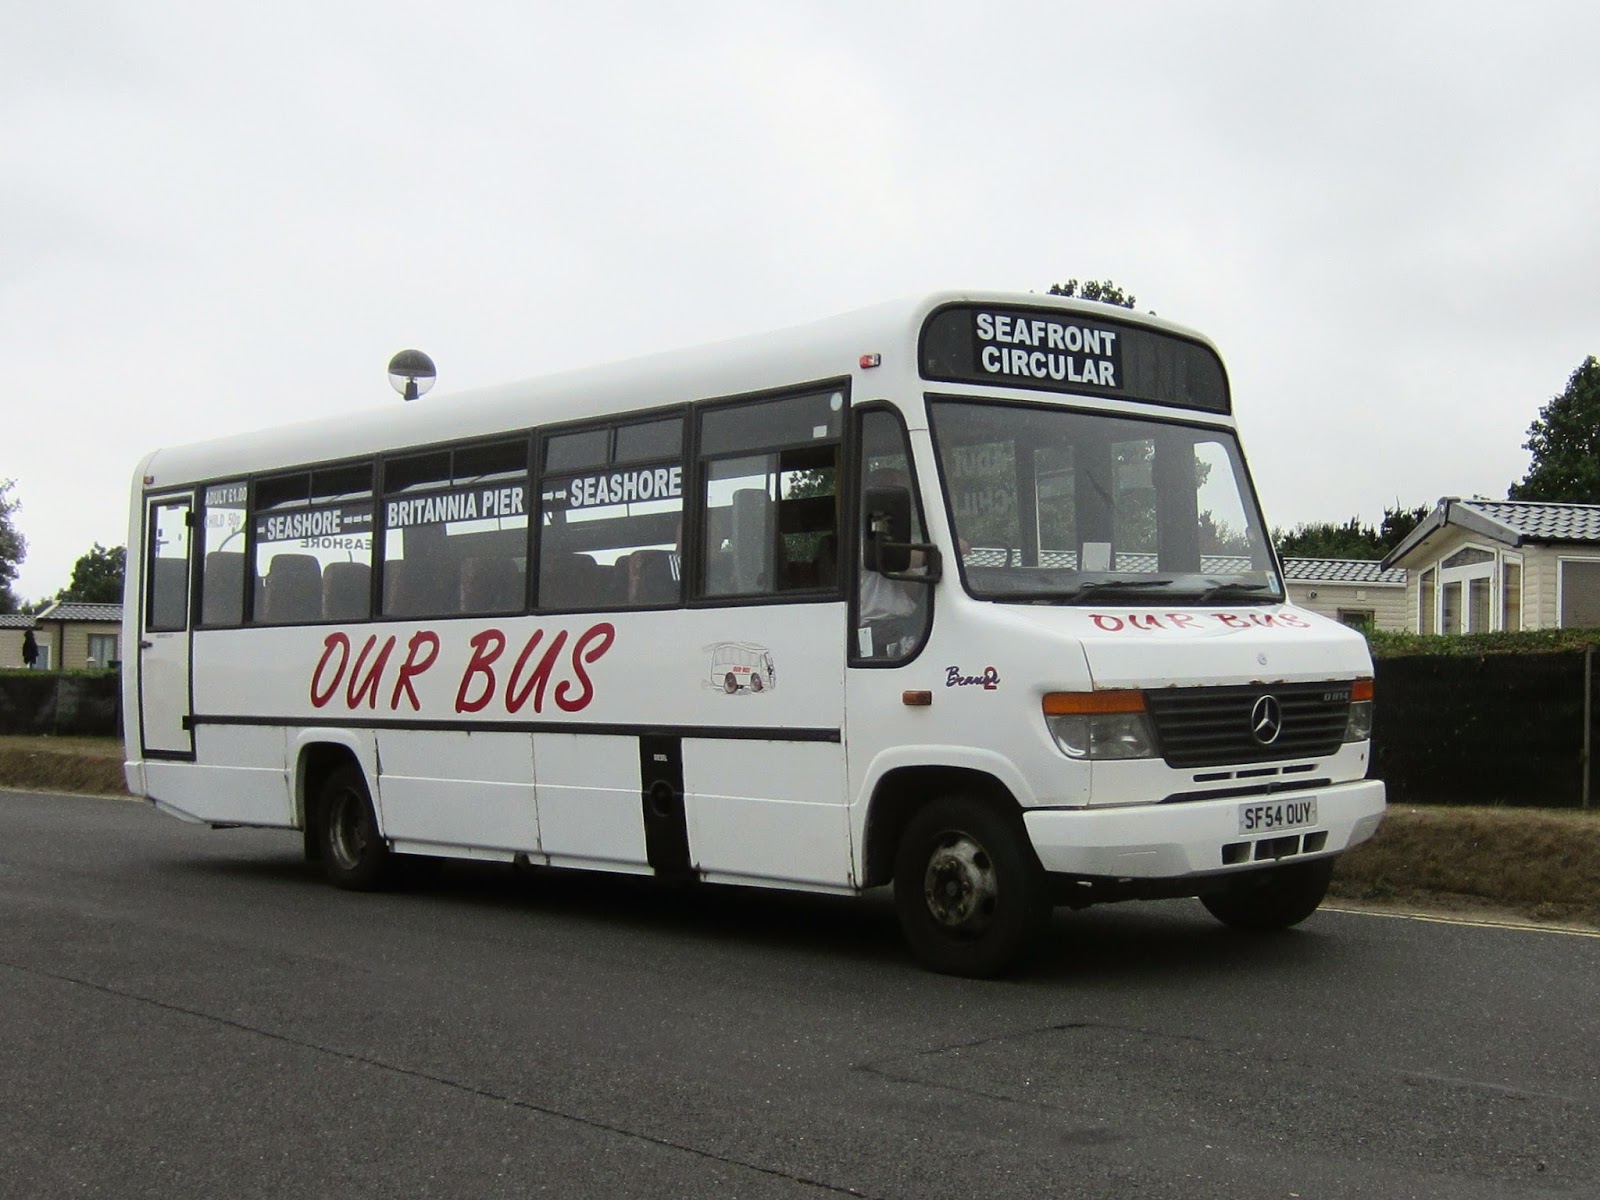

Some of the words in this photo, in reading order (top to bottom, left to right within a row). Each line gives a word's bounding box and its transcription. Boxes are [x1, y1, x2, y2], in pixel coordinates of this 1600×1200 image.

[976, 313, 1116, 356] SEAFRONT
[981, 346, 1116, 387] CIRCULAR
[387, 492, 478, 527] BRITANNIA
[482, 487, 523, 515] PIER
[570, 467, 682, 507] SEASHORE
[267, 509, 341, 540] SEASHORE
[1089, 613, 1204, 631] OUR
[1210, 613, 1311, 628] BUS
[310, 630, 440, 712] OUR
[455, 622, 615, 713] BUS
[1245, 805, 1283, 829] SF54
[1286, 802, 1311, 825] OUY
